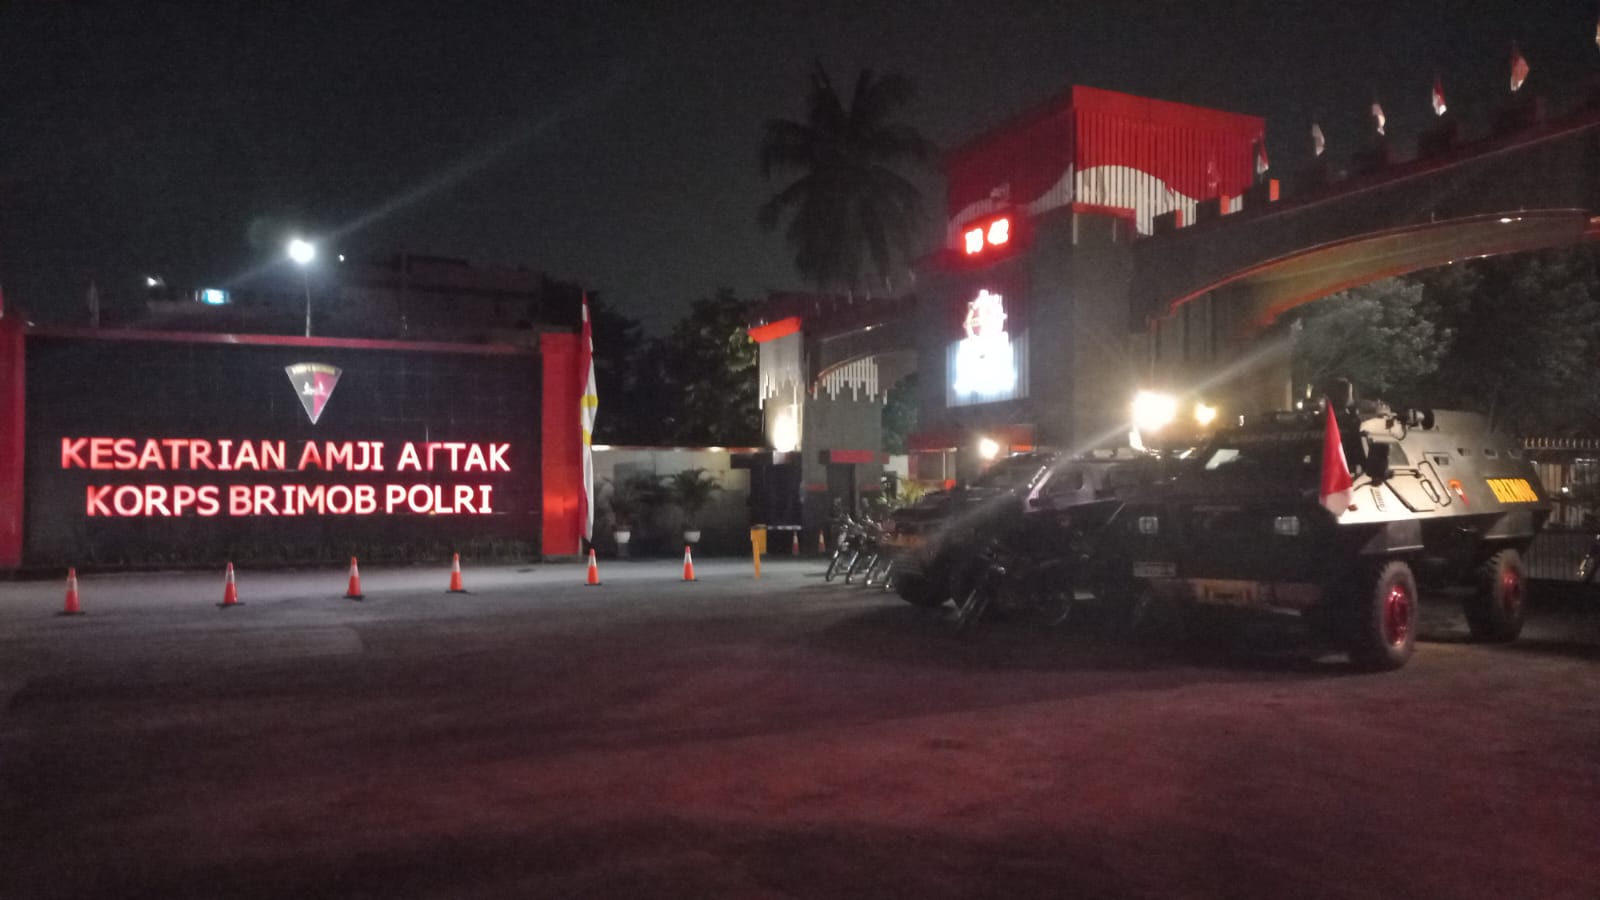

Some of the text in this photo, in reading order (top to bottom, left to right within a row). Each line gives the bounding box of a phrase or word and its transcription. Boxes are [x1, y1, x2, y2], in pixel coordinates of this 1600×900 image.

[61, 437, 511, 472] KESATRIAN AMJI ATTAK
[86, 484, 493, 517] KORPS BRIMOB POLRI
